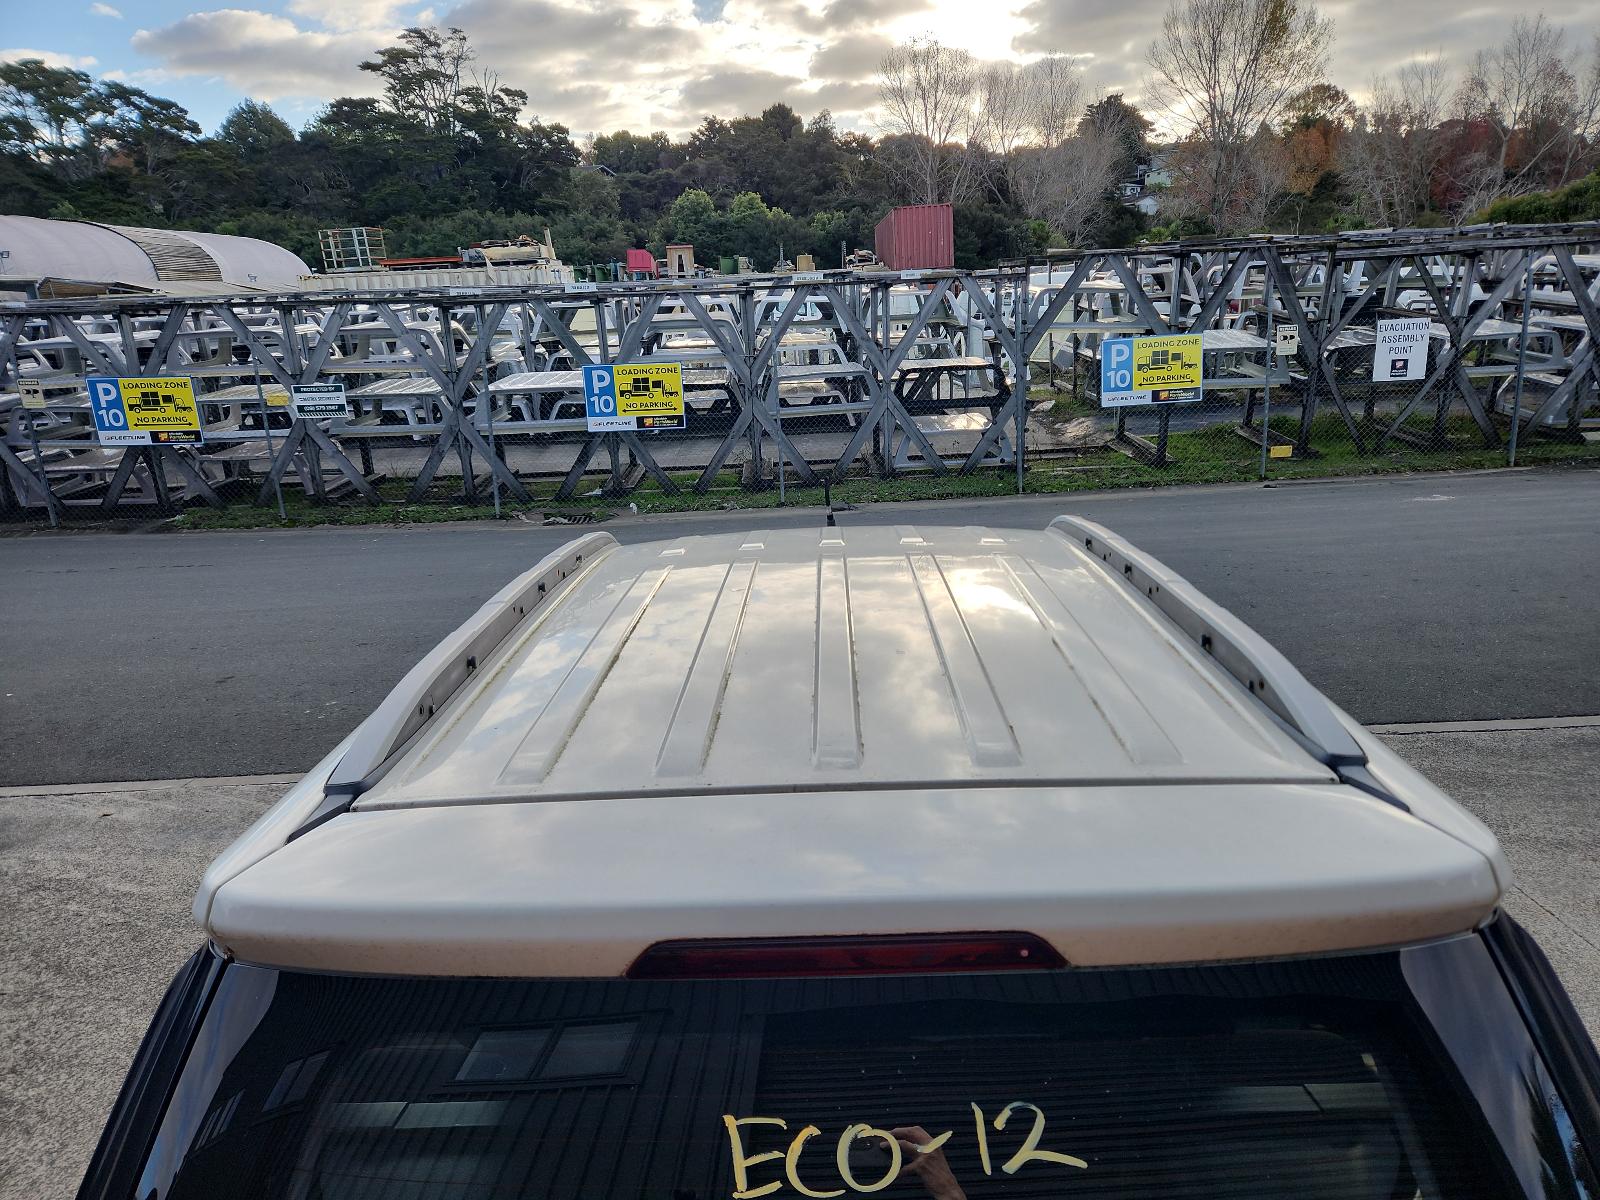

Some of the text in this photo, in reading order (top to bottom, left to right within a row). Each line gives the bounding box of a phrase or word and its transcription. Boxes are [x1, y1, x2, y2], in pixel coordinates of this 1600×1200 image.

[1379, 321, 1430, 333] EVACUATION
[1137, 338, 1200, 349] LOADING ZONE
[1381, 333, 1425, 343] ASSEMBLY
[1388, 345, 1413, 355] POINT
[1111, 343, 1130, 369] P
[616, 366, 679, 376] LOADING ZONE
[591, 369, 611, 394] P
[1106, 369, 1131, 388] 10
[1142, 373, 1191, 383] NO PARKING
[122, 381, 189, 390] LOADING ZONE
[95, 382, 117, 408] P
[589, 395, 614, 413] 10
[640, 401, 674, 409] PARKING
[97, 408, 124, 427] 10
[136, 416, 150, 424] NO
